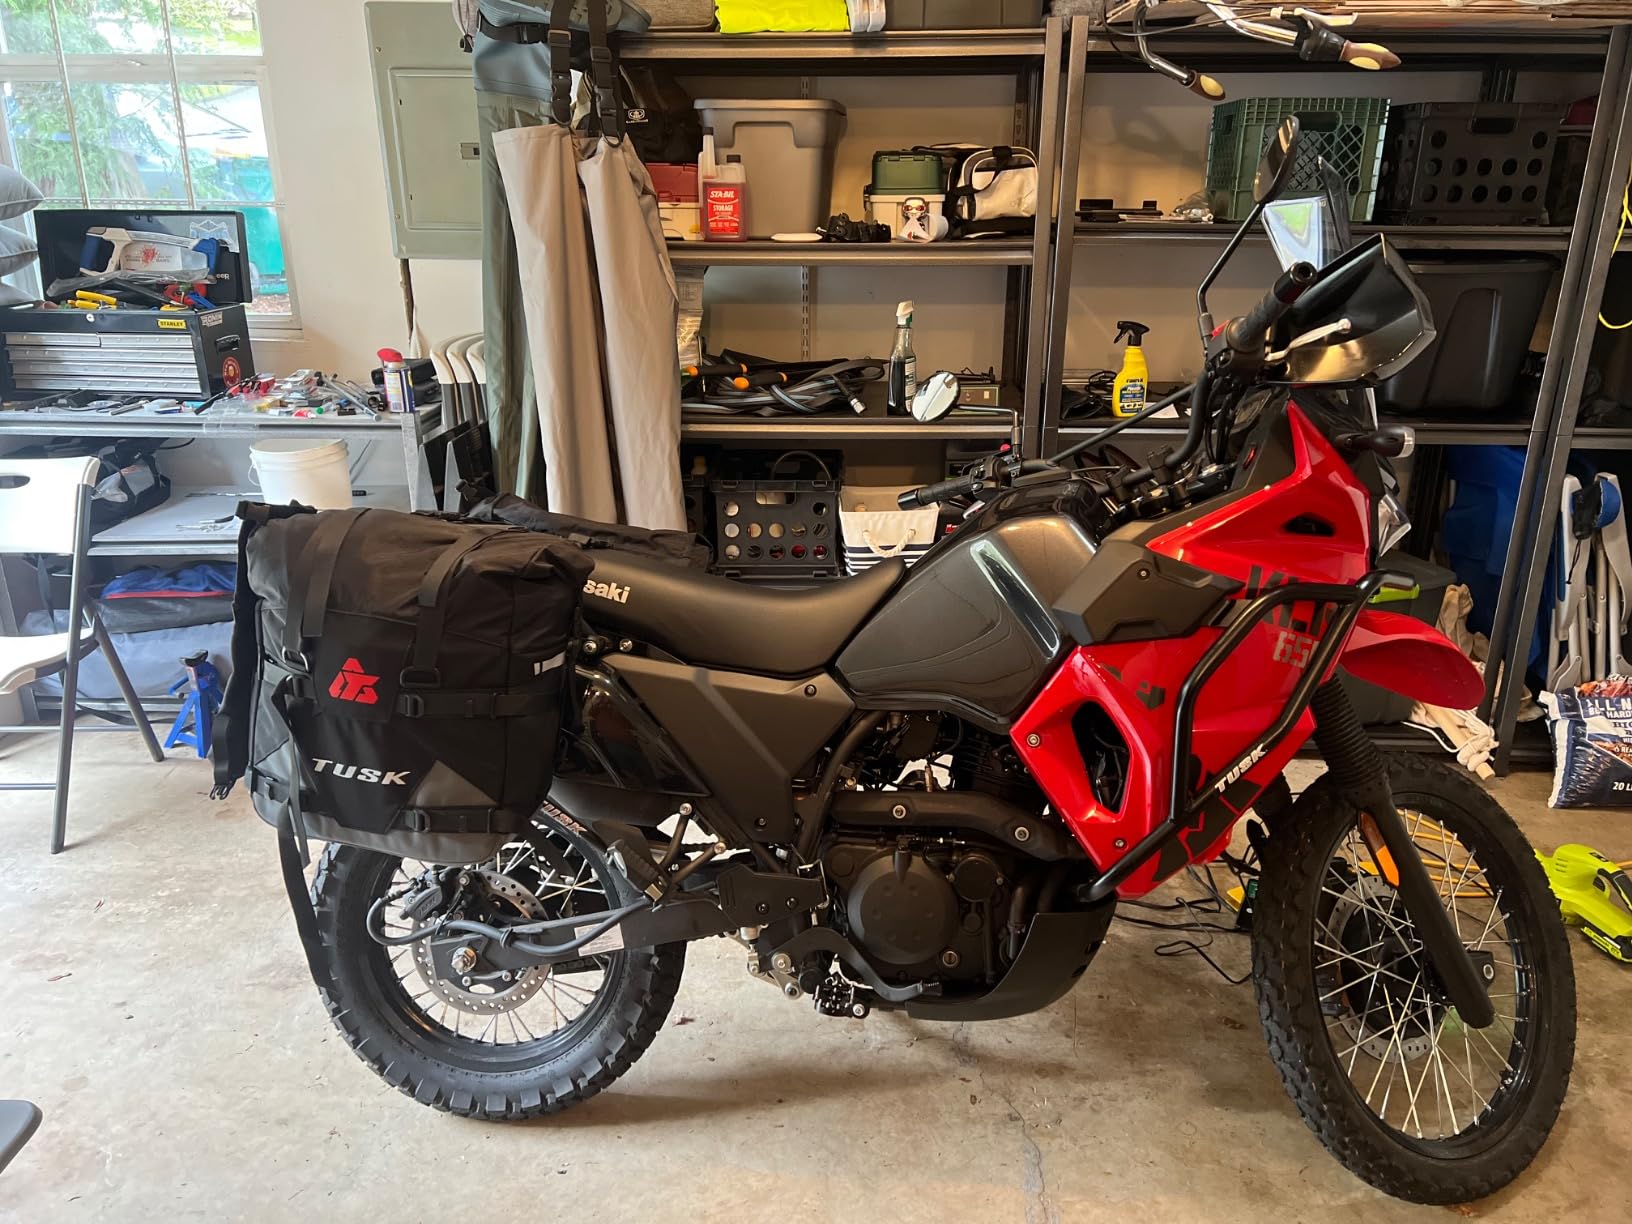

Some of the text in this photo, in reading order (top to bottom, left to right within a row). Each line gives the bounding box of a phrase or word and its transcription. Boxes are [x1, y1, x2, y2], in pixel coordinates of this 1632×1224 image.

[1273, 630, 1321, 669] 65
[1606, 710, 1632, 719] HARD
[312, 758, 411, 785] TUSK
[1214, 743, 1267, 793] TUSK
[1612, 781, 1632, 791] 20 L
[542, 800, 588, 837] USK
